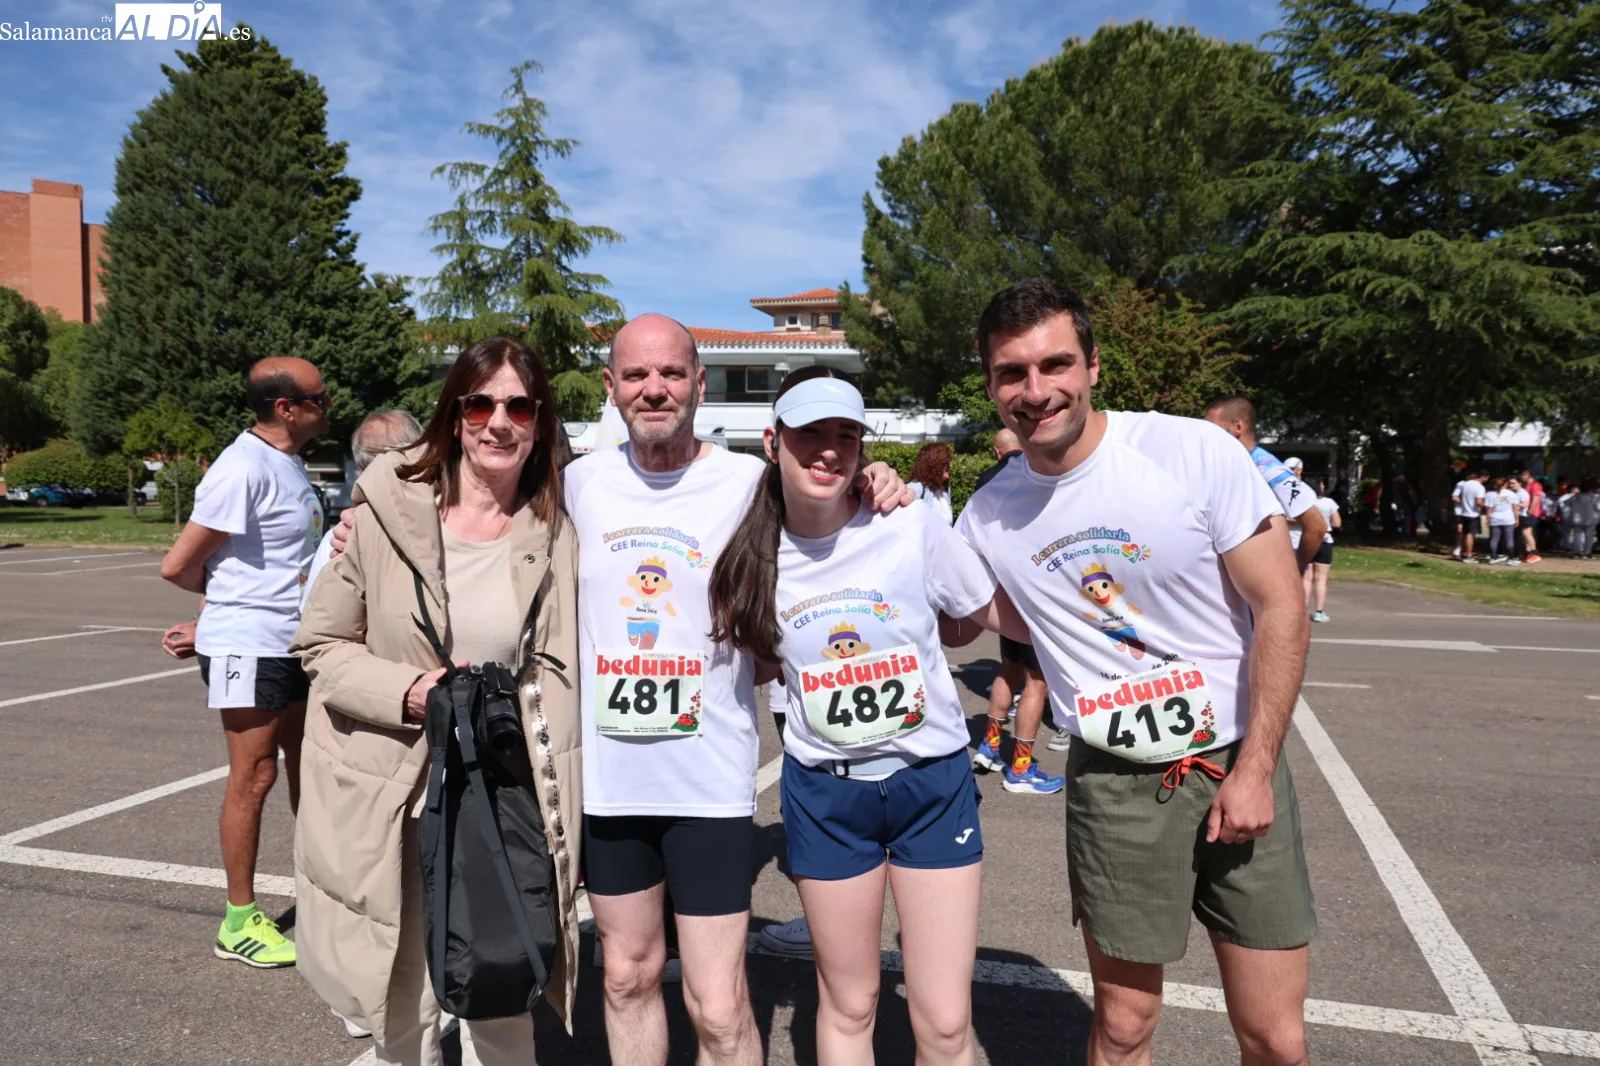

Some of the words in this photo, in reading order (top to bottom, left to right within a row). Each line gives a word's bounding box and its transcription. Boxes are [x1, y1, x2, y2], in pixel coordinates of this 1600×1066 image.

[608, 526, 652, 541] carrera
[651, 526, 700, 550] solidaria
[610, 541, 628, 552] CEE
[630, 539, 659, 549] Reina
[1038, 534, 1076, 561] carrera
[1075, 527, 1131, 543] solidaria
[1046, 556, 1063, 573] CEE
[1062, 547, 1090, 563] Reina
[1092, 544, 1120, 555] Sofía
[786, 593, 830, 619] carrera
[829, 588, 883, 603] solidaria
[793, 613, 812, 630] CEE
[812, 606, 842, 620] Reina
[596, 654, 702, 676] bedunia
[801, 653, 919, 693] bedunia
[608, 678, 680, 715] 481
[826, 679, 909, 728] 482
[1077, 669, 1205, 717] bedunia
[1106, 696, 1195, 749] 413
